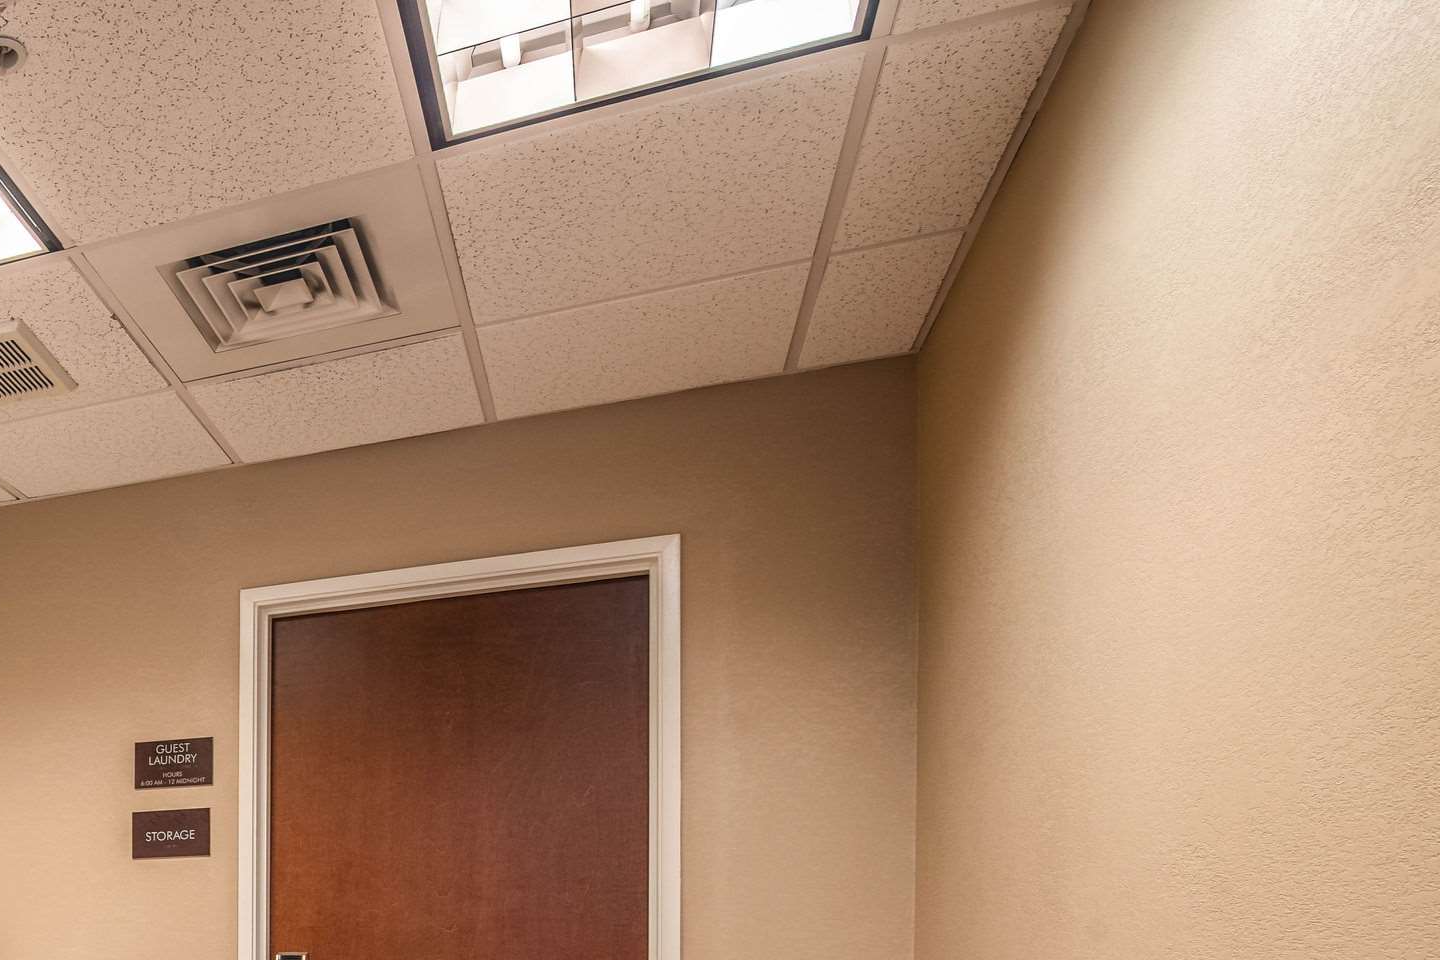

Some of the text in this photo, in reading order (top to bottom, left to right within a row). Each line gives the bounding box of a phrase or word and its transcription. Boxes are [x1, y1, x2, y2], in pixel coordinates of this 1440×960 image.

[156, 743, 190, 754] GUEST
[148, 753, 197, 766] LAUNDRY
[162, 771, 183, 779] HOURS
[175, 776, 206, 785] MIDNIGHT
[145, 829, 196, 842] STORAGE
